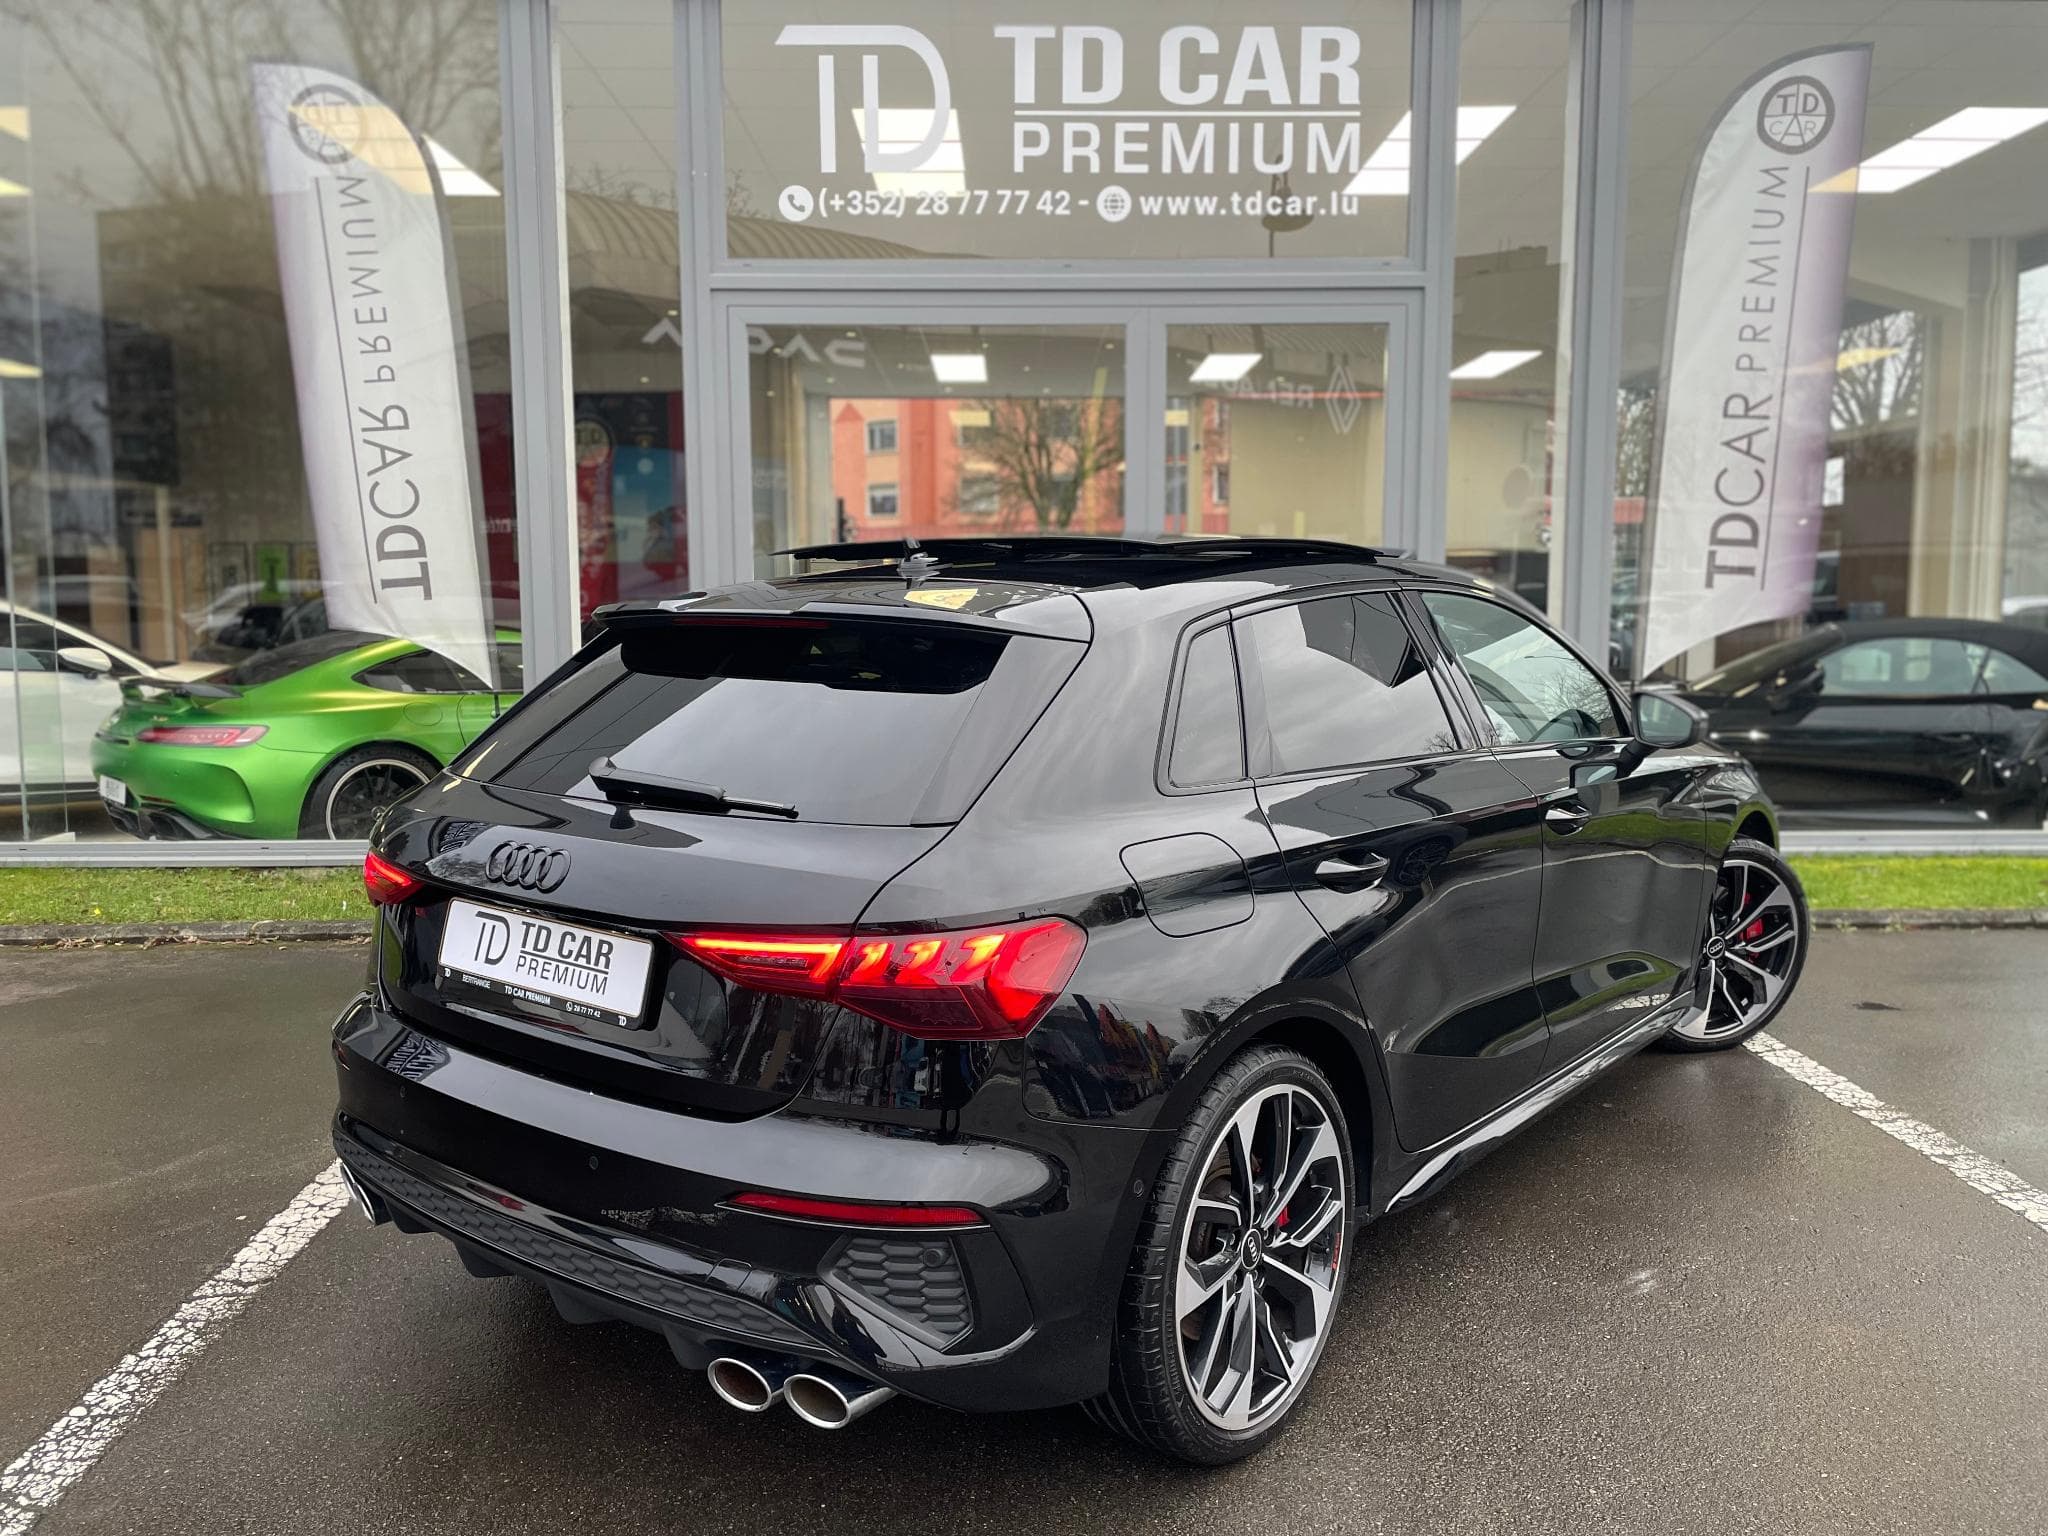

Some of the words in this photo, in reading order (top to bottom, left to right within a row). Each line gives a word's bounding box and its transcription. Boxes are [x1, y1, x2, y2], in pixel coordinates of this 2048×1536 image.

[994, 26, 1123, 105] TD
[1159, 25, 1361, 105] CAR
[1014, 122, 1361, 175] PREMIUM
[818, 187, 906, 217] (+352)
[916, 190, 950, 215] 28
[958, 190, 989, 215] 77
[996, 190, 1030, 215] 77
[1036, 190, 1071, 215] 42
[1139, 190, 1359, 216] www.tdcar.lu
[1735, 165, 1789, 373] PREMIUM
[521, 921, 552, 953] TD
[558, 931, 613, 969] CAR
[516, 955, 608, 995] PREMIUM
